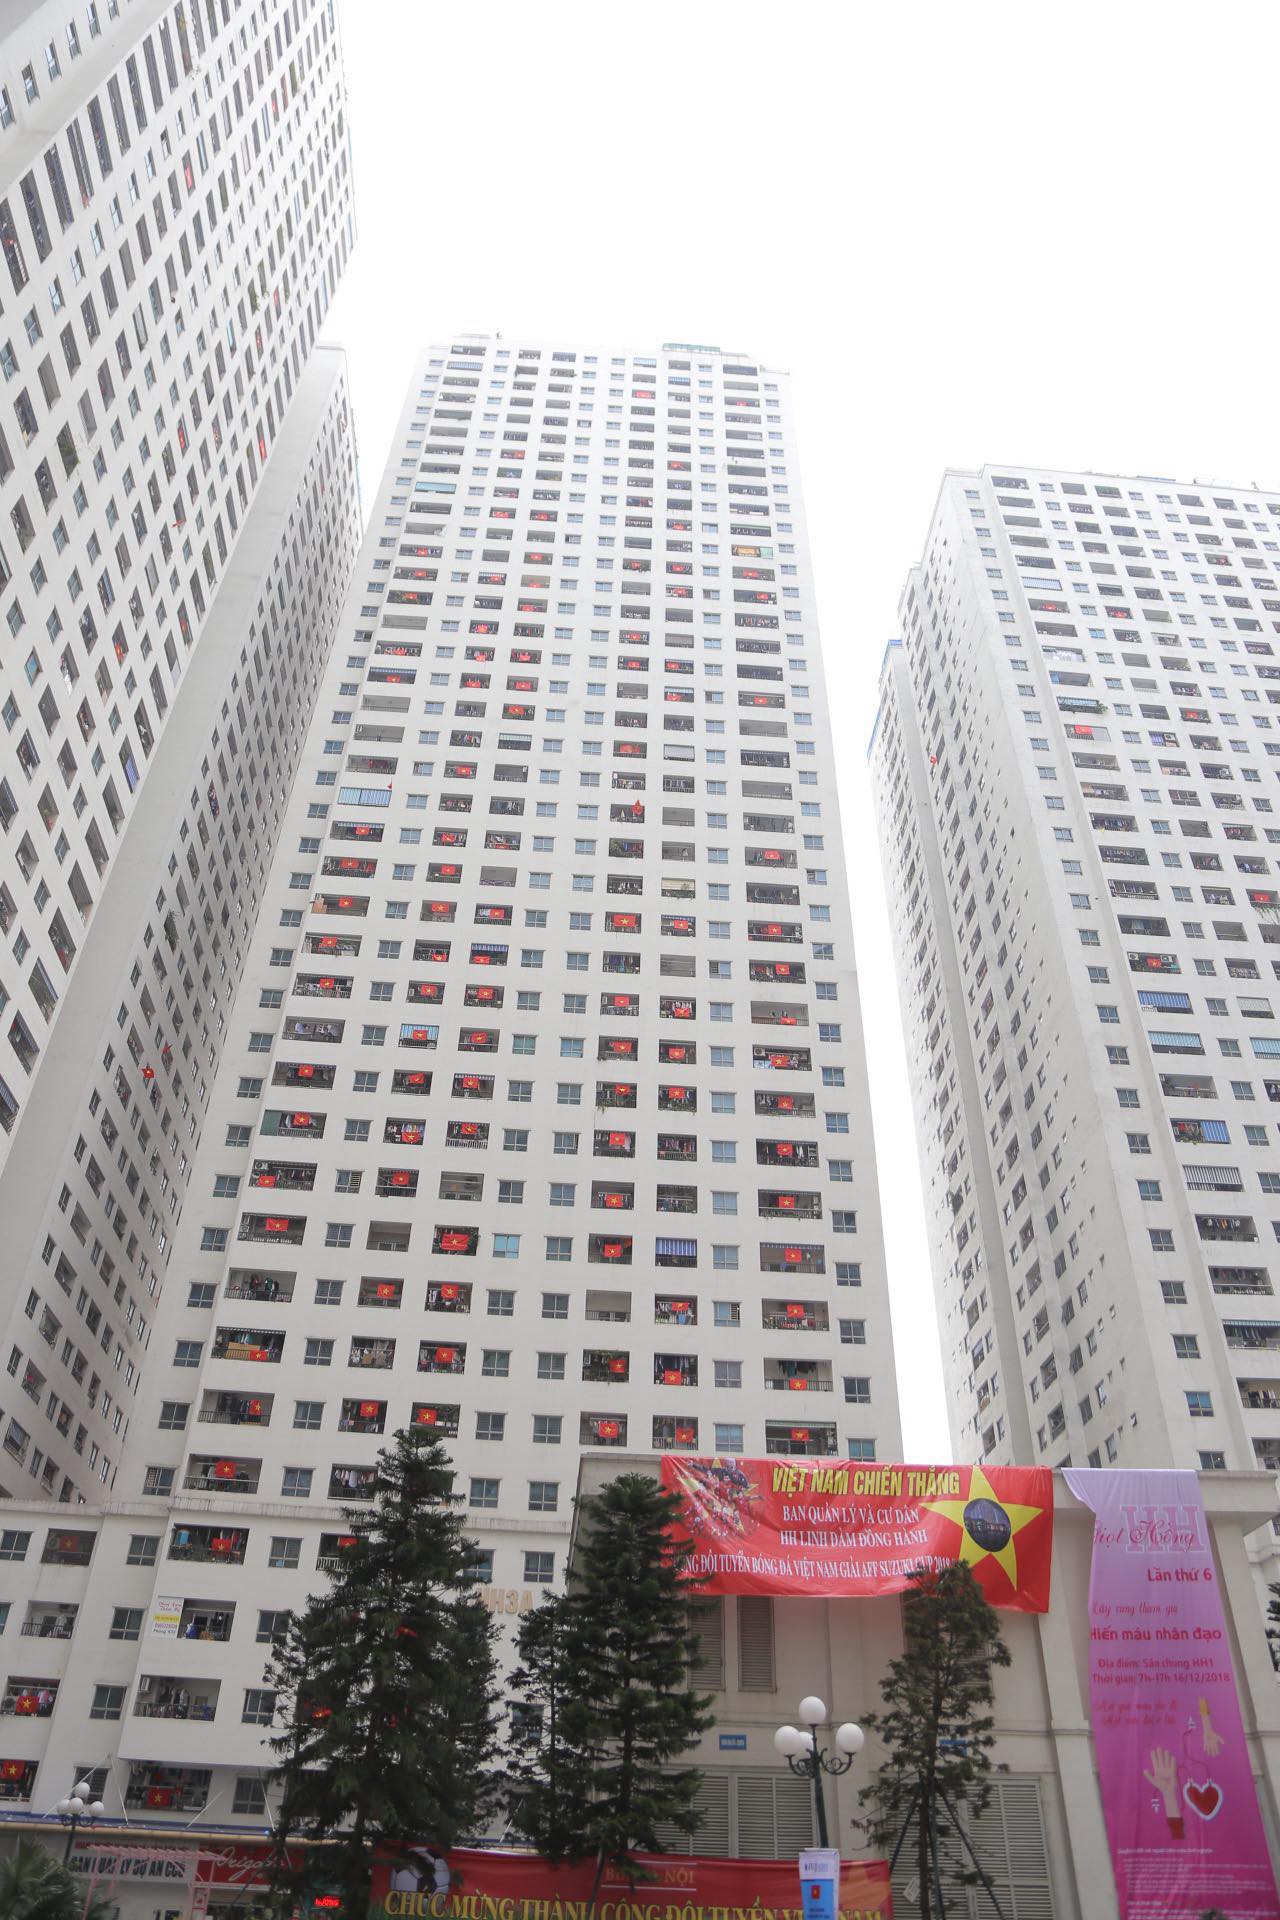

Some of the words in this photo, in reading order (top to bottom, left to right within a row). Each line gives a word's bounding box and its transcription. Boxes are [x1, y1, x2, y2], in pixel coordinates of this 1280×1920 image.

[772, 1464, 806, 1498] VIỆT
[811, 1467, 849, 1495] NAM
[854, 1464, 902, 1496] CHIẾN
[907, 1464, 960, 1497] THẮNG
[783, 1505, 806, 1521] BAN
[808, 1503, 840, 1524] QUẢN
[842, 1504, 858, 1523] LÝ
[858, 1504, 874, 1524] VÀ
[877, 1508, 893, 1524] CƯ
[895, 1505, 920, 1523] DÂN
[780, 1530, 798, 1545] HH
[800, 1530, 828, 1547] LINH
[830, 1528, 857, 1547] ĐÀM
[858, 1529, 891, 1547] ĐỒNG
[894, 1528, 928, 1546] HÀNH
[700, 1549, 717, 1575] ĐỘI
[719, 1550, 750, 1573] TUYỂN
[751, 1553, 777, 1574] BÓNG
[779, 1555, 793, 1576] ĐÁ
[794, 1556, 815, 1580] VIỆT
[816, 1561, 839, 1578] NAM
[839, 1557, 861, 1578] GIẢI
[862, 1560, 878, 1577] AFF
[879, 1558, 914, 1576] SUZUKI
[915, 1555, 933, 1573] CUP
[1147, 1566, 1171, 1582] Lần
[1175, 1567, 1199, 1582] thứ
[1203, 1568, 1212, 1581] 6
[1122, 1626, 1151, 1641] máu
[1155, 1626, 1189, 1641] nhân
[1193, 1626, 1222, 1643] đạo
[664, 1867, 696, 1887] NỘI
[384, 1885, 446, 1918] CHÚC
[451, 1888, 515, 1920] MỪNG
[519, 1892, 597, 1920] THÀNH
[600, 1897, 661, 1920] CÔNG
